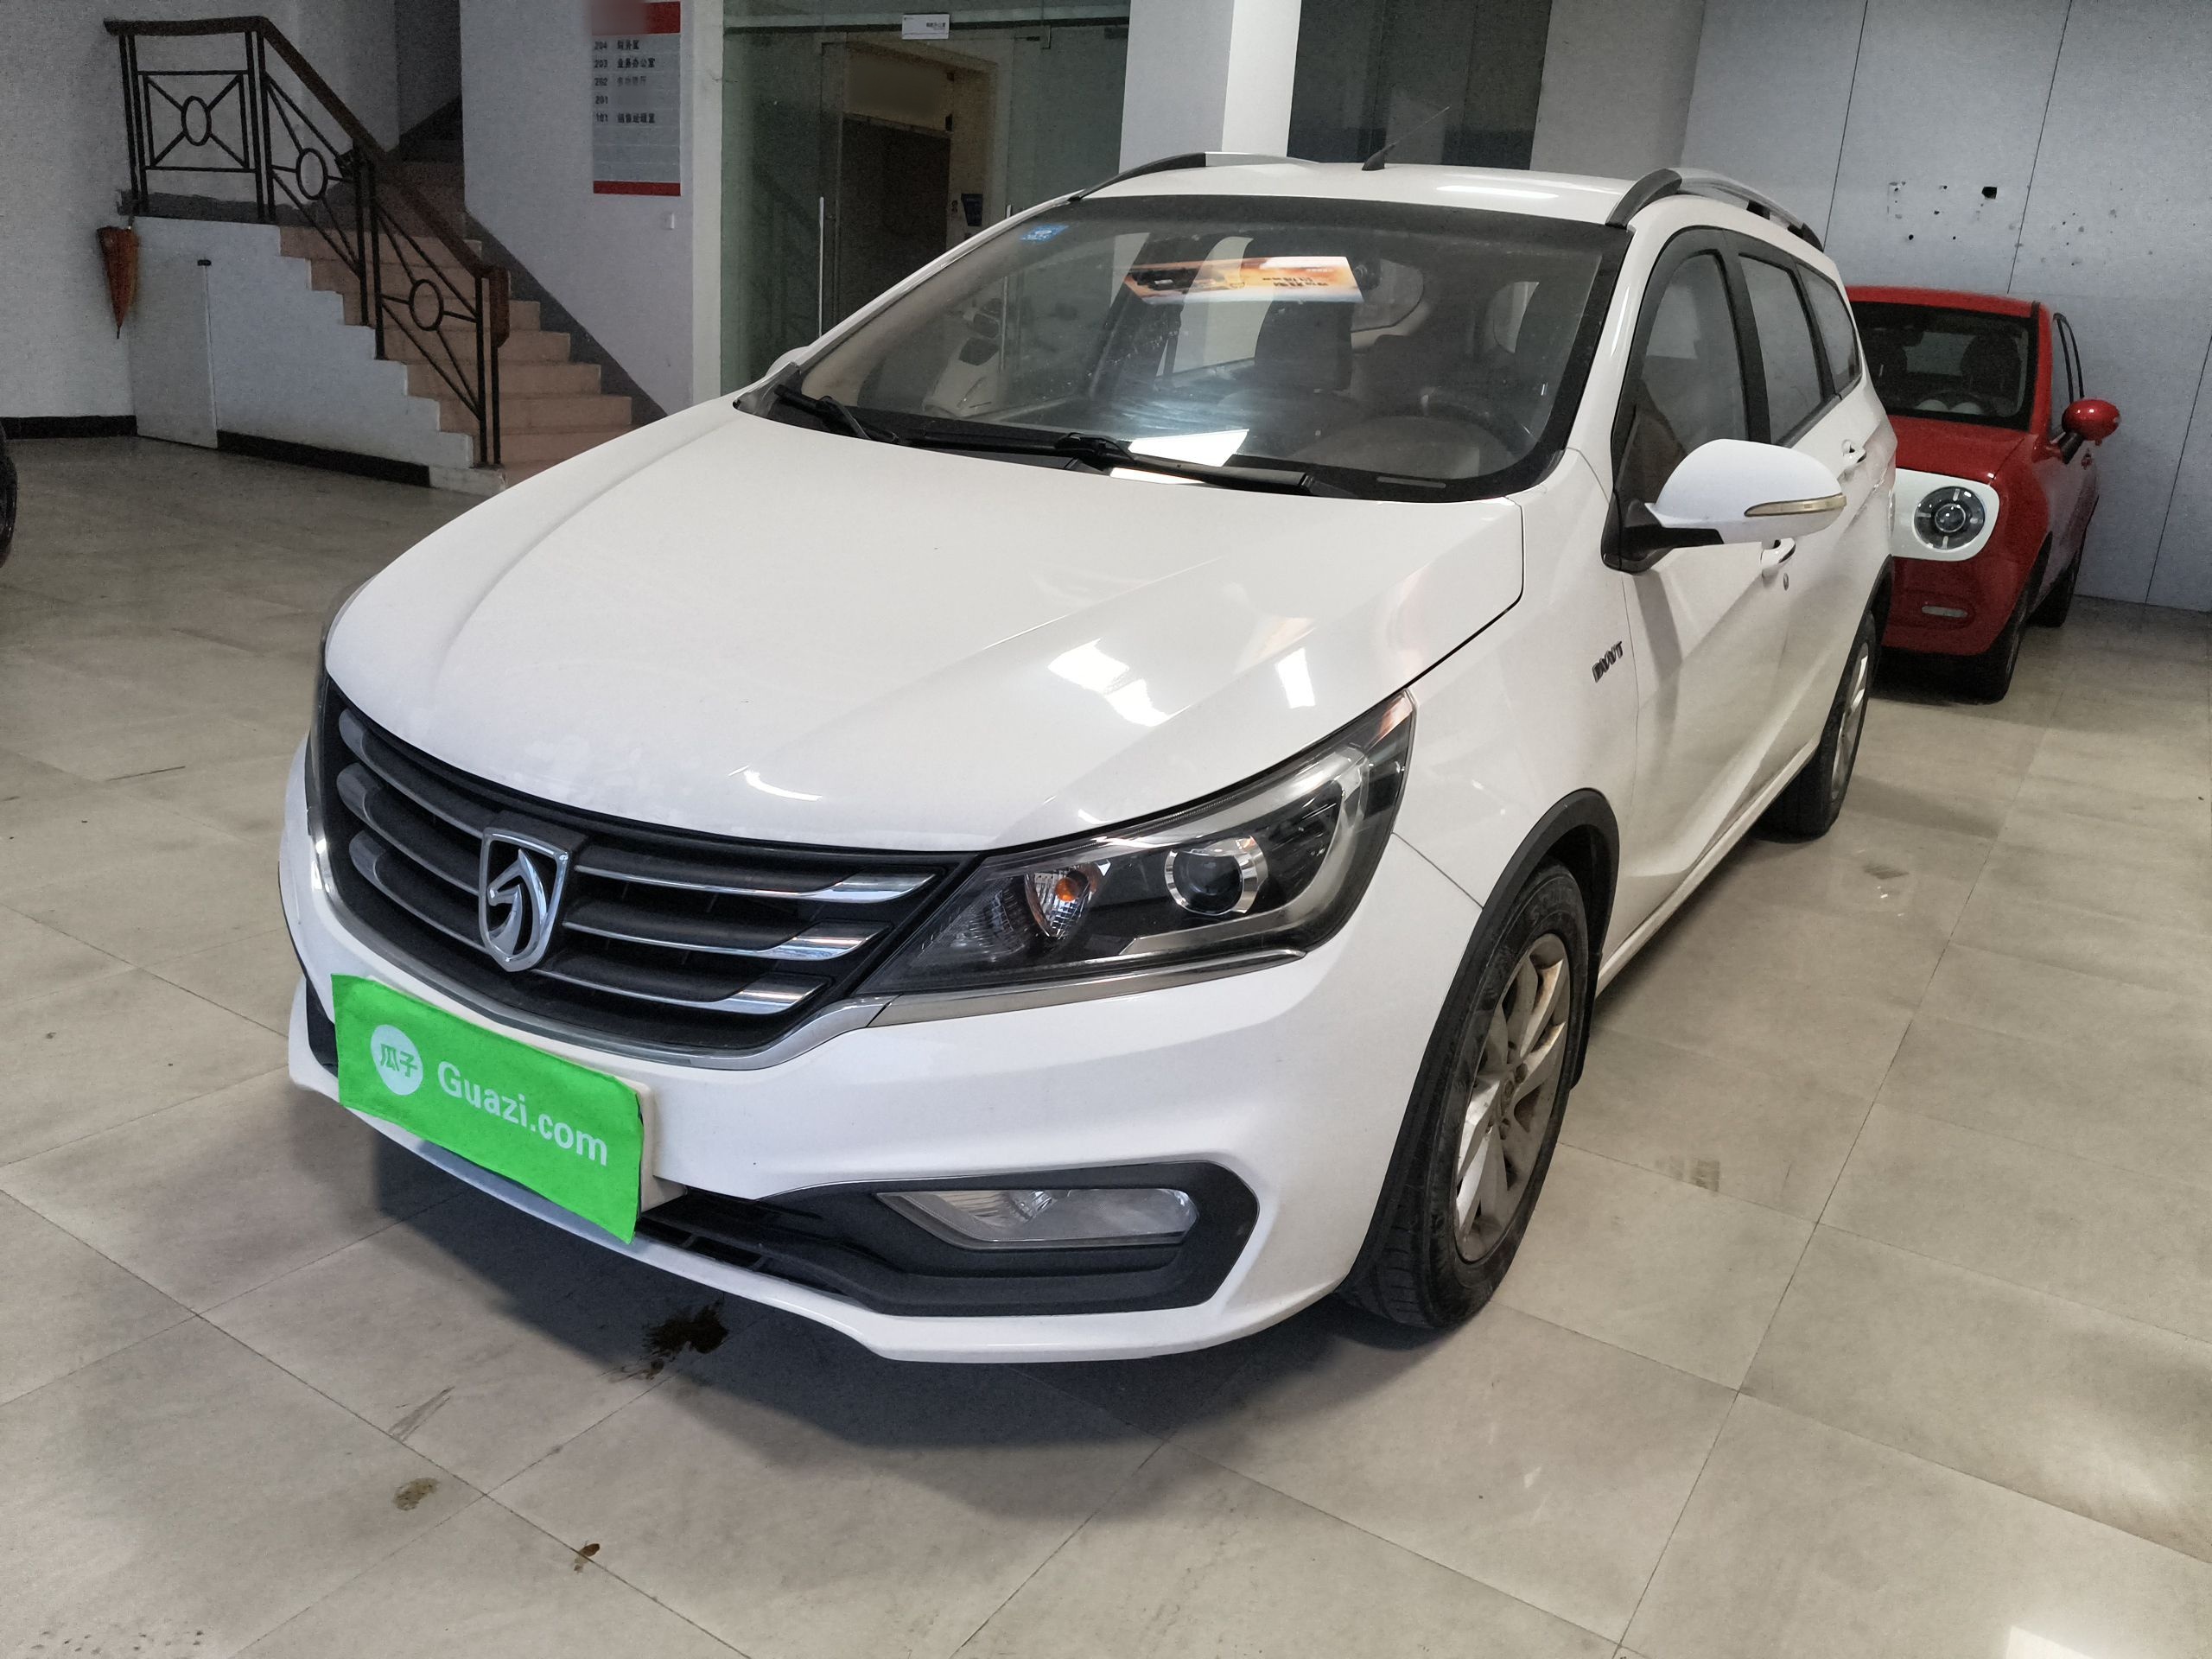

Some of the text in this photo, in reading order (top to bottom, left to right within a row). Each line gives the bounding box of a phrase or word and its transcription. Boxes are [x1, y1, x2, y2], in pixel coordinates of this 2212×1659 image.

[594, 41, 607, 50] 204
[594, 59, 608, 68] 203
[594, 95, 608, 105] 201
[379, 1043, 419, 1078] 瓜子
[437, 1060, 608, 1166] Guazi.com
